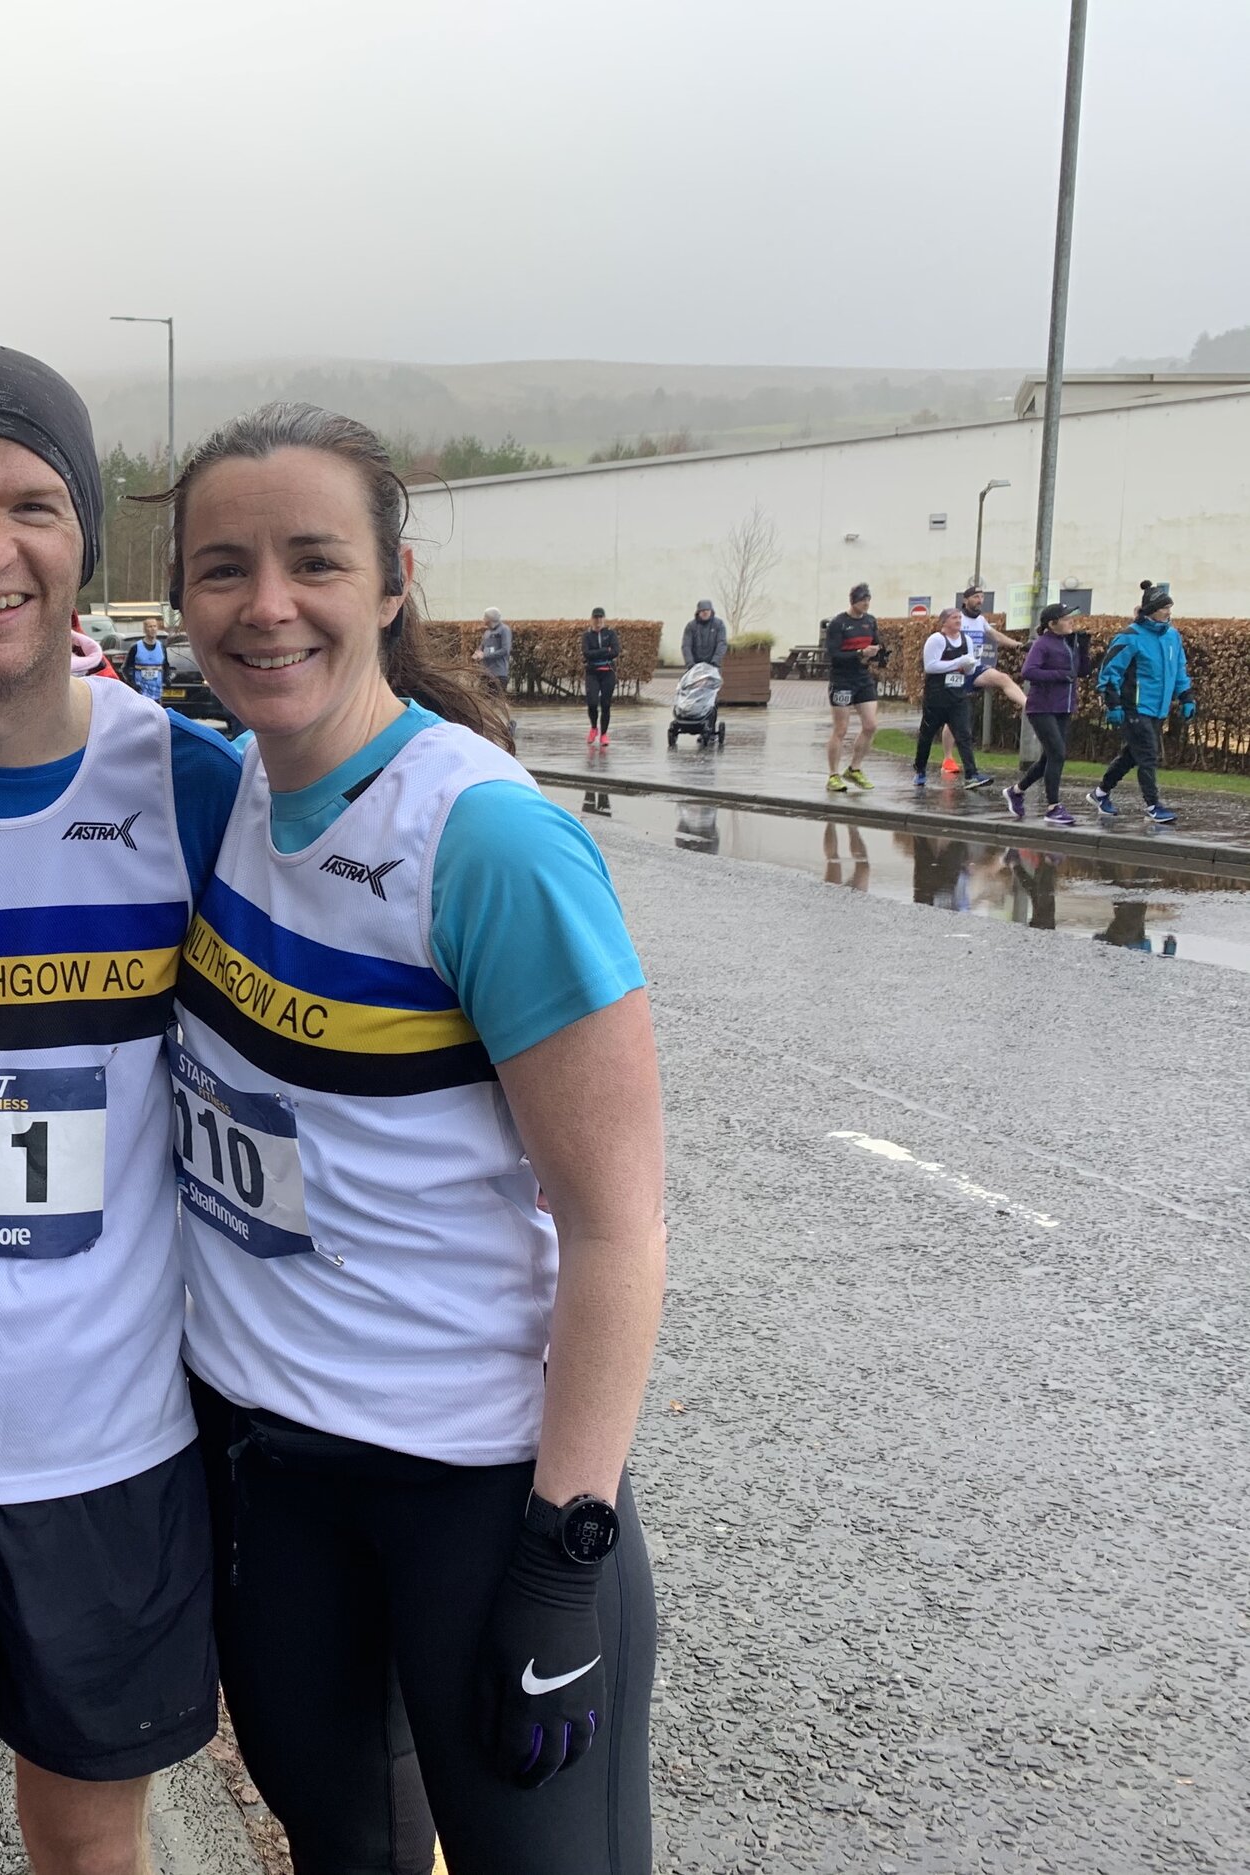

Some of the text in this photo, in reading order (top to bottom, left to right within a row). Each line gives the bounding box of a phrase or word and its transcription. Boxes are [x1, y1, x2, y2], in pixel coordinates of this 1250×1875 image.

[61, 811, 142, 851] FASTRAX
[319, 854, 405, 902] FASTRAX
[103, 958, 145, 992] AC
[277, 997, 328, 1039] AC
[178, 1053, 217, 1095] START
[198, 1085, 232, 1116] FITNESS
[174, 1087, 264, 1208] 110
[188, 1182, 250, 1241] Strathmore
